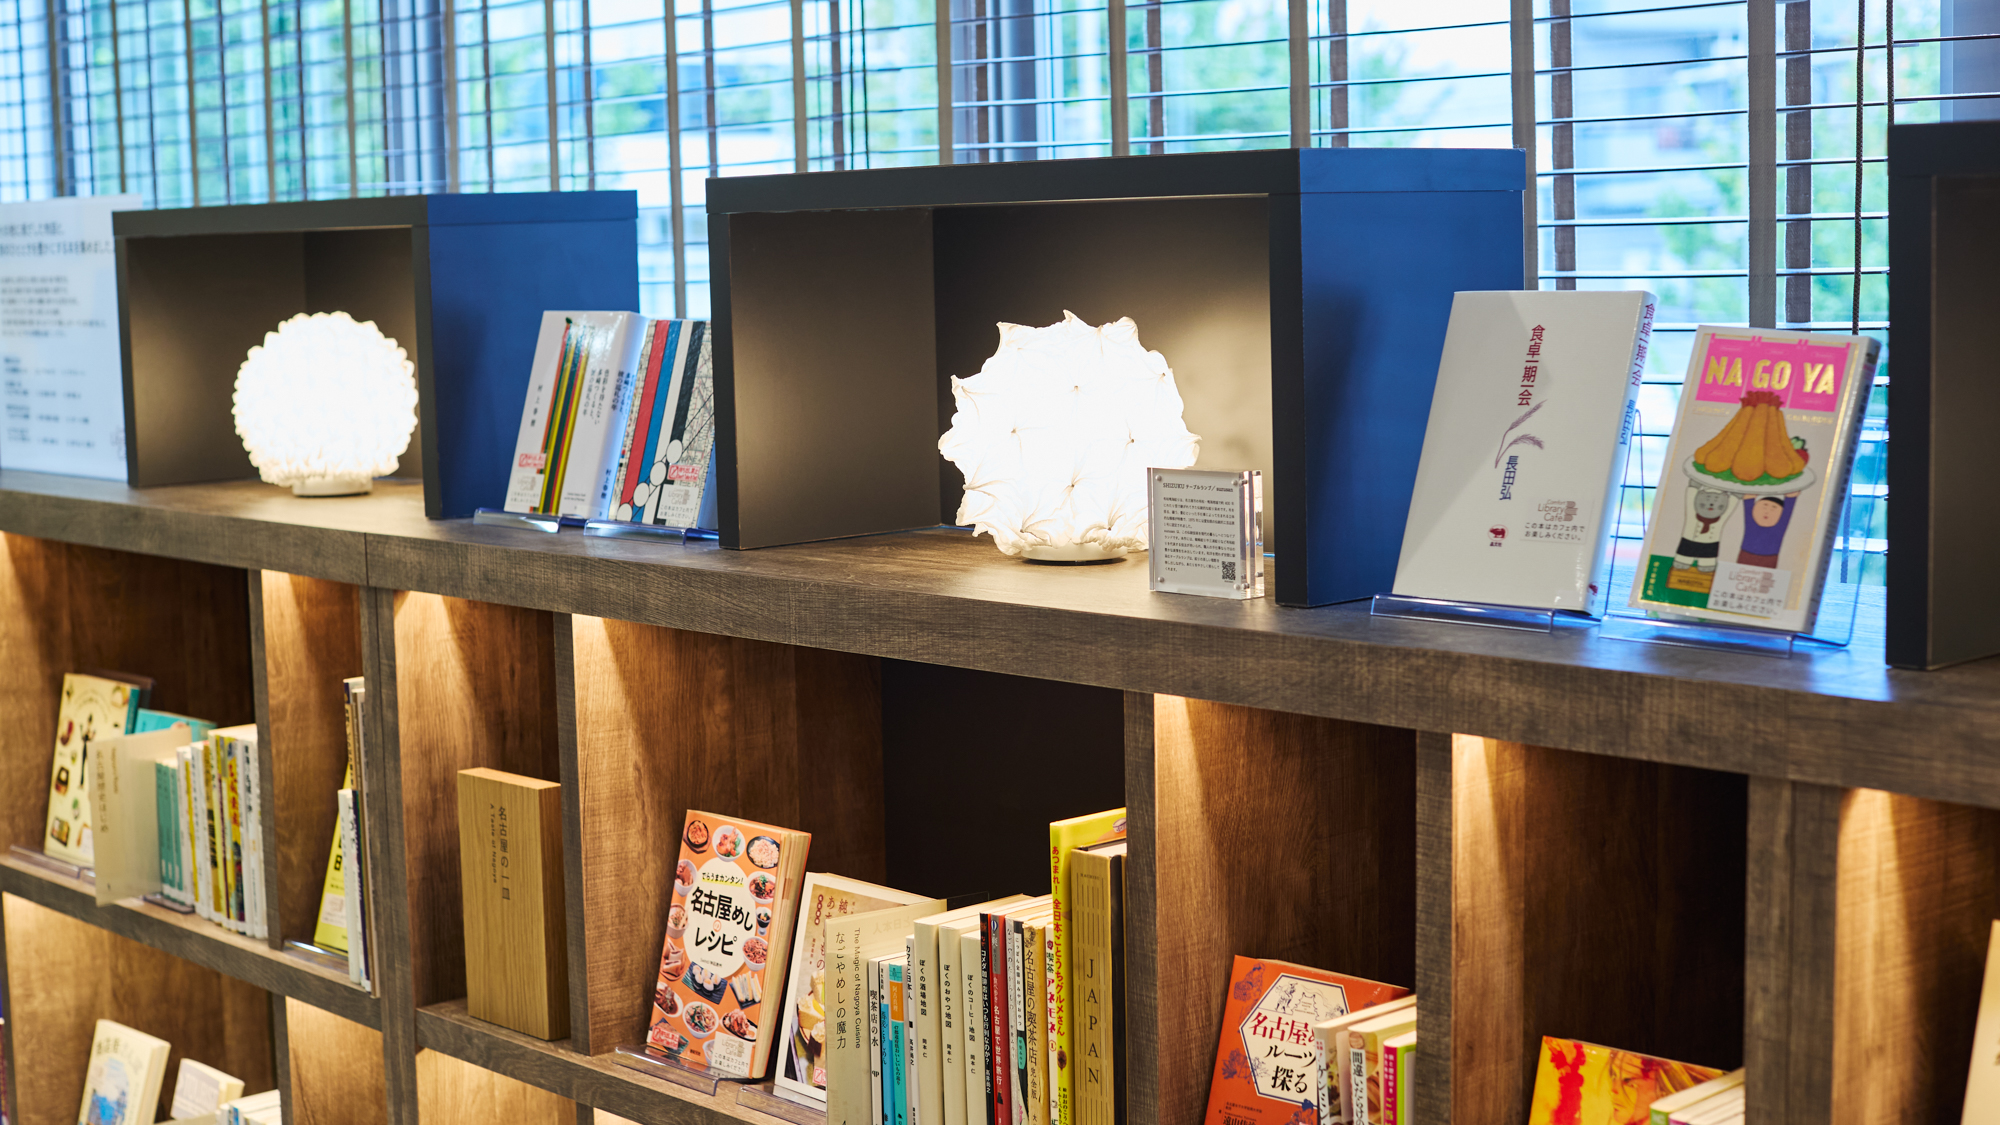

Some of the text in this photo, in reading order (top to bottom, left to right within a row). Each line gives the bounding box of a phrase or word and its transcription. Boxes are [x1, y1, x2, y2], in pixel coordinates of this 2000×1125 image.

[1517, 324, 1546, 406] 食卓一期一会
[1704, 355, 1835, 395] NA GO YA
[1499, 455, 1519, 501] 長田弘
[1525, 522, 1585, 532] この本はカフェ内で
[1538, 503, 1565, 516] Library
[1525, 531, 1581, 541] お楽しみください。
[1713, 590, 1782, 607] この本はカフェ内で
[1728, 571, 1761, 584] Library
[1713, 599, 1779, 616] お楽しみください。
[498, 806, 511, 901] 名古屋の一口
[691, 886, 754, 932] 名古屋めし
[695, 926, 738, 956] レシピ
[853, 943, 861, 972] Magic
[854, 974, 860, 984] of
[919, 959, 927, 1016] ぼくの酒場地図
[1052, 898, 1065, 1037] 全日本ごとうちグルメさん
[835, 932, 846, 1050] なごやめしの魔力
[853, 986, 861, 1017] Nagoya
[944, 964, 952, 1028] ぼくのおやつ地図
[967, 974, 975, 1042] ぼくのコーヒー地図
[1025, 950, 1037, 1067] 名古屋の喫茶店
[1047, 978, 1056, 1033] アネモネ
[869, 989, 879, 1047] 喫茶店の水
[1087, 958, 1100, 1084] JAPAN
[993, 1004, 1003, 1086] 名古屋で世界旅行
[1264, 1044, 1316, 1068] ルーツ
[1030, 1067, 1038, 1100] 完全版
[1271, 1065, 1308, 1093] 探る
[1317, 1064, 1330, 1125] ケンミン
[1352, 1051, 1364, 1125] 間違いだらけの
